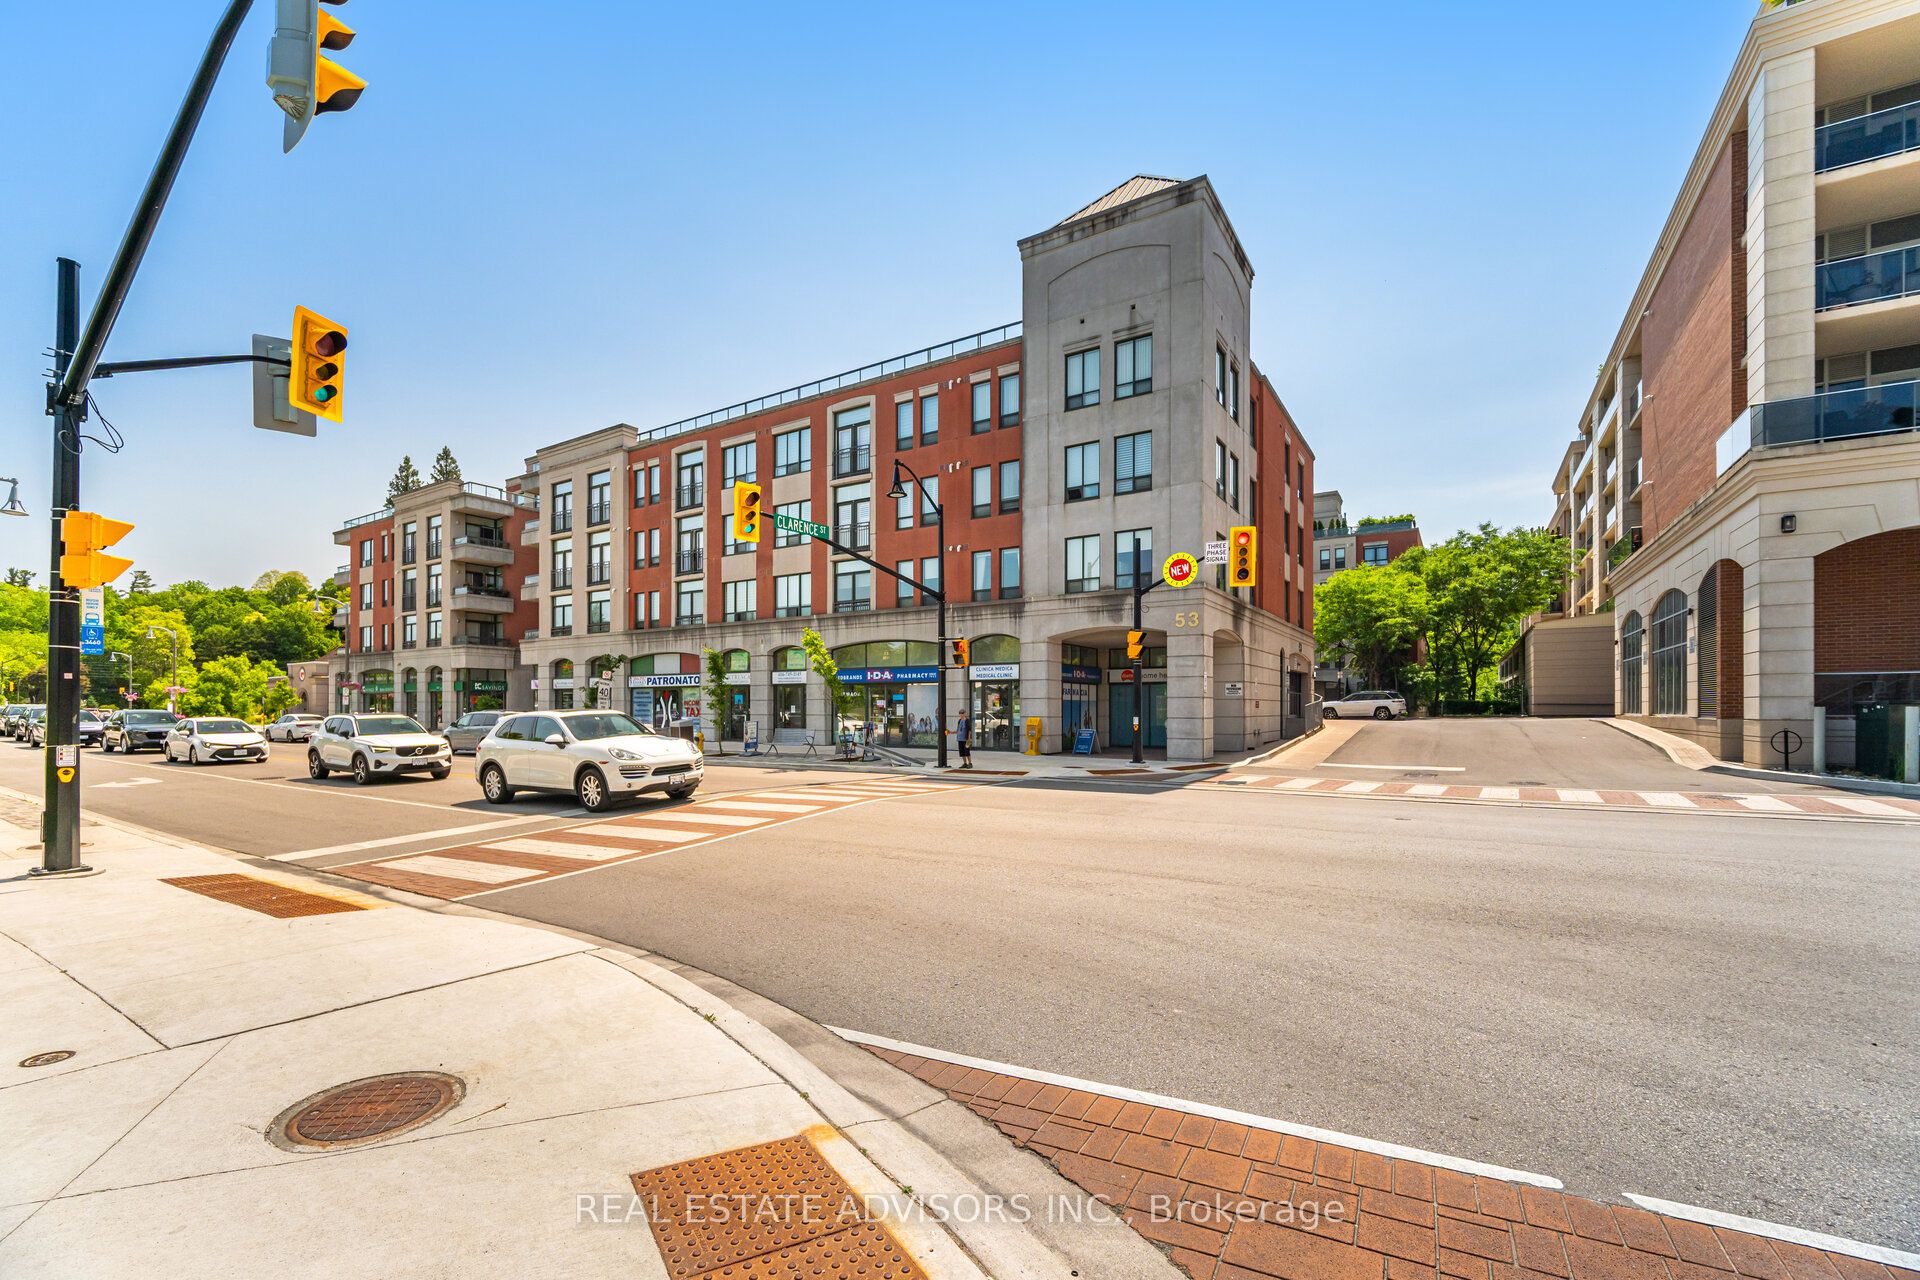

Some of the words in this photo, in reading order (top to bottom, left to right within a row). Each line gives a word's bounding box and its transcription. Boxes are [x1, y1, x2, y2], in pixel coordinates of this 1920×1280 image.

[777, 516, 818, 536] CLARENCE
[819, 526, 826, 534] ST
[1170, 563, 1190, 577] NEW
[1175, 611, 1199, 628] 53
[647, 676, 700, 685] PATRONATO
[599, 687, 609, 697] 40
